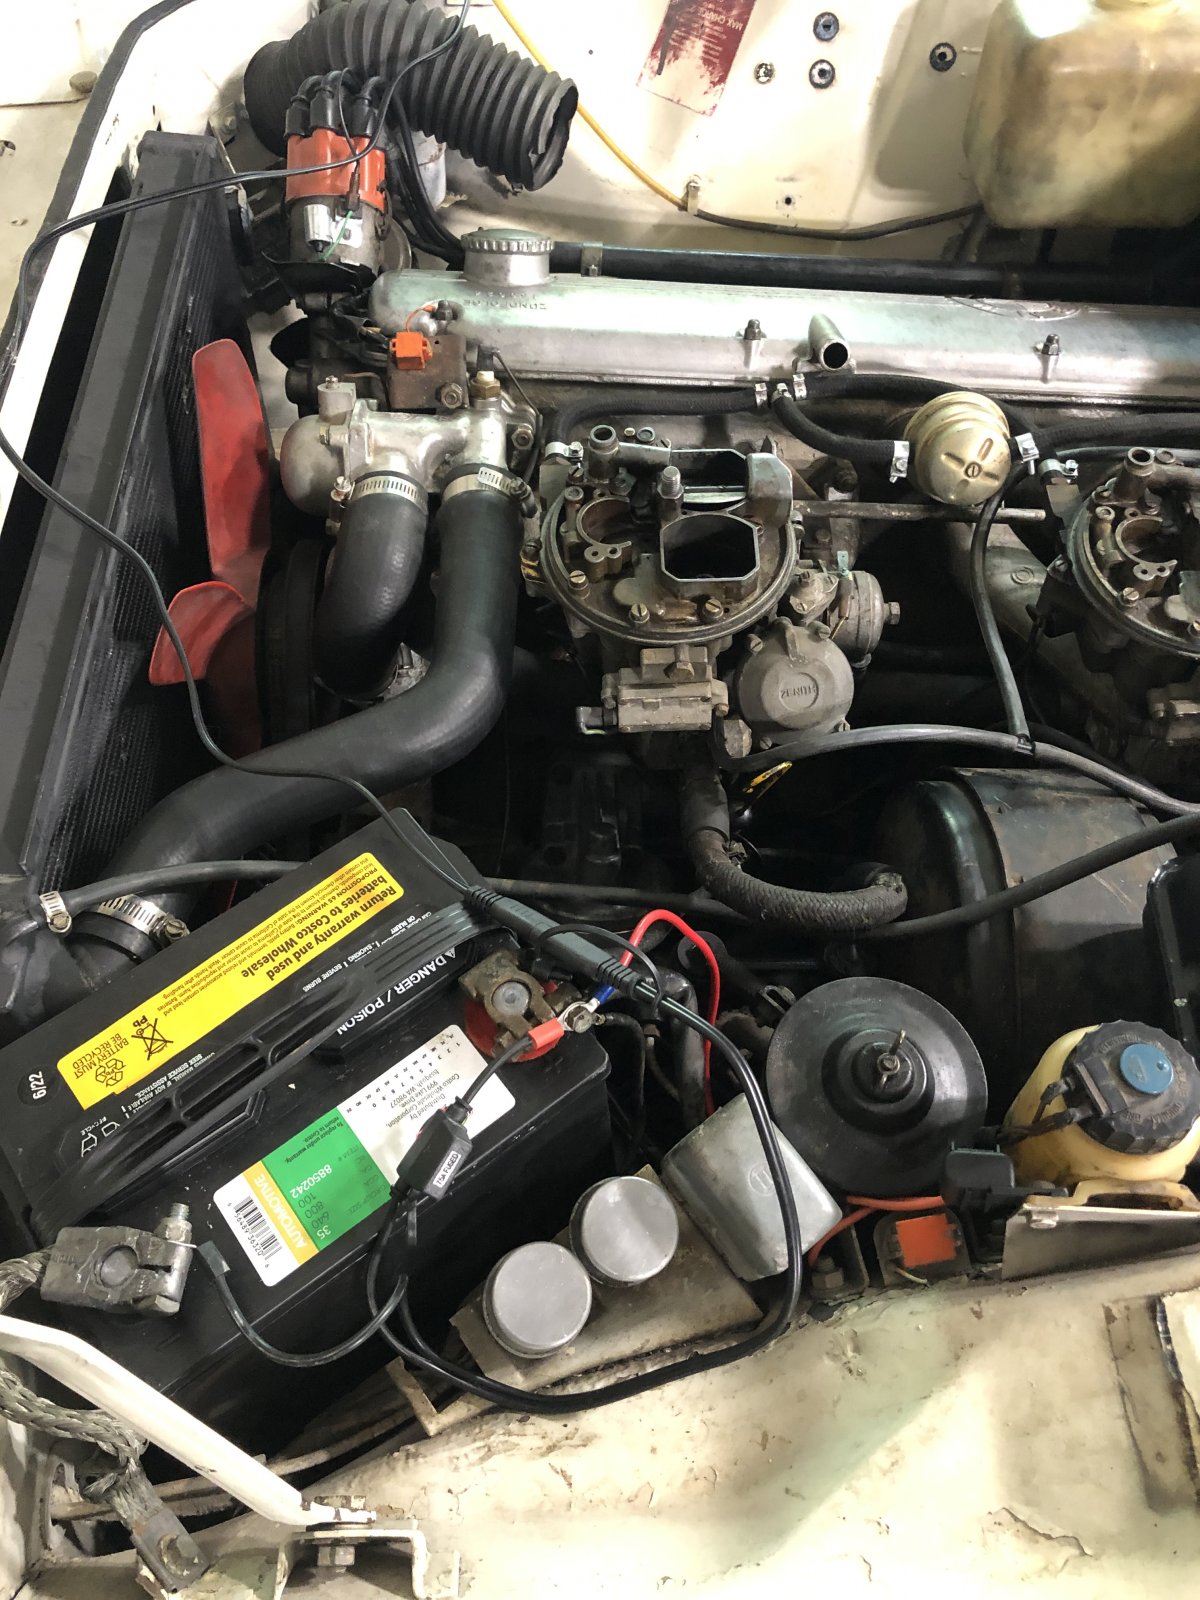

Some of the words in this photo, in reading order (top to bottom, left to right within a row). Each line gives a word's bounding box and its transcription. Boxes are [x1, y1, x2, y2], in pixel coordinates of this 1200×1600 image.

[725, 18, 743, 31] MAX
[344, 862, 360, 875] contain
[359, 857, 368, 865] also
[363, 862, 373, 870] lead
[333, 873, 346, 883] other
[335, 866, 378, 897] PROPOSITION
[313, 880, 335, 897] chemicals
[318, 884, 340, 901] chemicals
[339, 874, 387, 910] batteries
[299, 894, 315, 906] known
[304, 898, 320, 910] known
[327, 894, 337, 903] 65
[359, 884, 396, 914] Return
[276, 912, 288, 922] state
[287, 907, 296, 915] the
[292, 911, 301, 919] the
[294, 900, 328, 925] WARNING:
[328, 904, 343, 918] to
[406, 914, 415, 923] OR
[279, 922, 295, 935] Battery
[281, 916, 293, 926] state
[294, 913, 331, 941] Costco
[312, 907, 362, 946] warranty
[251, 922, 273, 939] California
[257, 926, 278, 943] California
[234, 939, 248, 950] cause
[239, 944, 253, 955] cause
[246, 942, 268, 959] terminals
[290, 940, 316, 962] and
[347, 942, 372, 962] SMOKING
[206, 958, 220, 969] Wash
[225, 952, 240, 964] cancer
[237, 956, 247, 964] and
[240, 935, 298, 980] Wholesale
[193, 967, 208, 979] hands
[216, 962, 226, 971] and
[222, 962, 239, 975] related
[265, 956, 294, 981] used
[320, 962, 342, 980] SEVERE
[183, 976, 194, 986] after
[189, 968, 218, 989] reproductive
[198, 972, 223, 991] accessories
[392, 954, 448, 995] DANGER
[302, 976, 322, 992] BURNS
[182, 989, 199, 1003] contain
[382, 989, 395, 1002] /
[157, 995, 177, 1012] Batteries
[172, 1000, 183, 1010] lead
[163, 1007, 173, 1016] and
[335, 996, 384, 1035] POISON
[131, 1015, 147, 1028] Pb
[109, 1032, 121, 1044] BE
[71, 1039, 111, 1070] RECYCLED
[95, 1037, 128, 1063] BATTERY
[187, 1052, 202, 1065] SEEK
[72, 1059, 96, 1079] MUST
[105, 1068, 115, 1077] Pb
[166, 1061, 189, 1079] SERVICE
[29, 1071, 46, 1099] 6/22
[134, 1074, 168, 1099] ASSISTANCE.
[425, 1079, 438, 1090] 999
[441, 1072, 460, 1088] Costco
[153, 1084, 165, 1094] NOT
[405, 1085, 416, 1095] WA
[413, 1087, 427, 1098] Lake
[415, 1084, 444, 1106] Wholesale
[126, 1090, 154, 1111] AVAILABLE
[388, 1092, 407, 1108] 98027
[415, 1092, 446, 1115] Distributed
[323, 1115, 339, 1128] return
[384, 1102, 418, 1129] Corporation,
[408, 1111, 418, 1121] by
[318, 1124, 337, 1139] replace
[305, 1136, 321, 1149] under
[442, 1152, 459, 1173] FUSED
[288, 1163, 333, 1199] 8850242
[296, 1191, 316, 1209] 100
[254, 1173, 307, 1249] AUTOMOTIVE
[303, 1200, 325, 1219] 800
[309, 1210, 331, 1229] 640
[233, 1212, 250, 1233] 56489
[246, 1234, 265, 1256] 36320
[315, 1224, 332, 1239] 35
